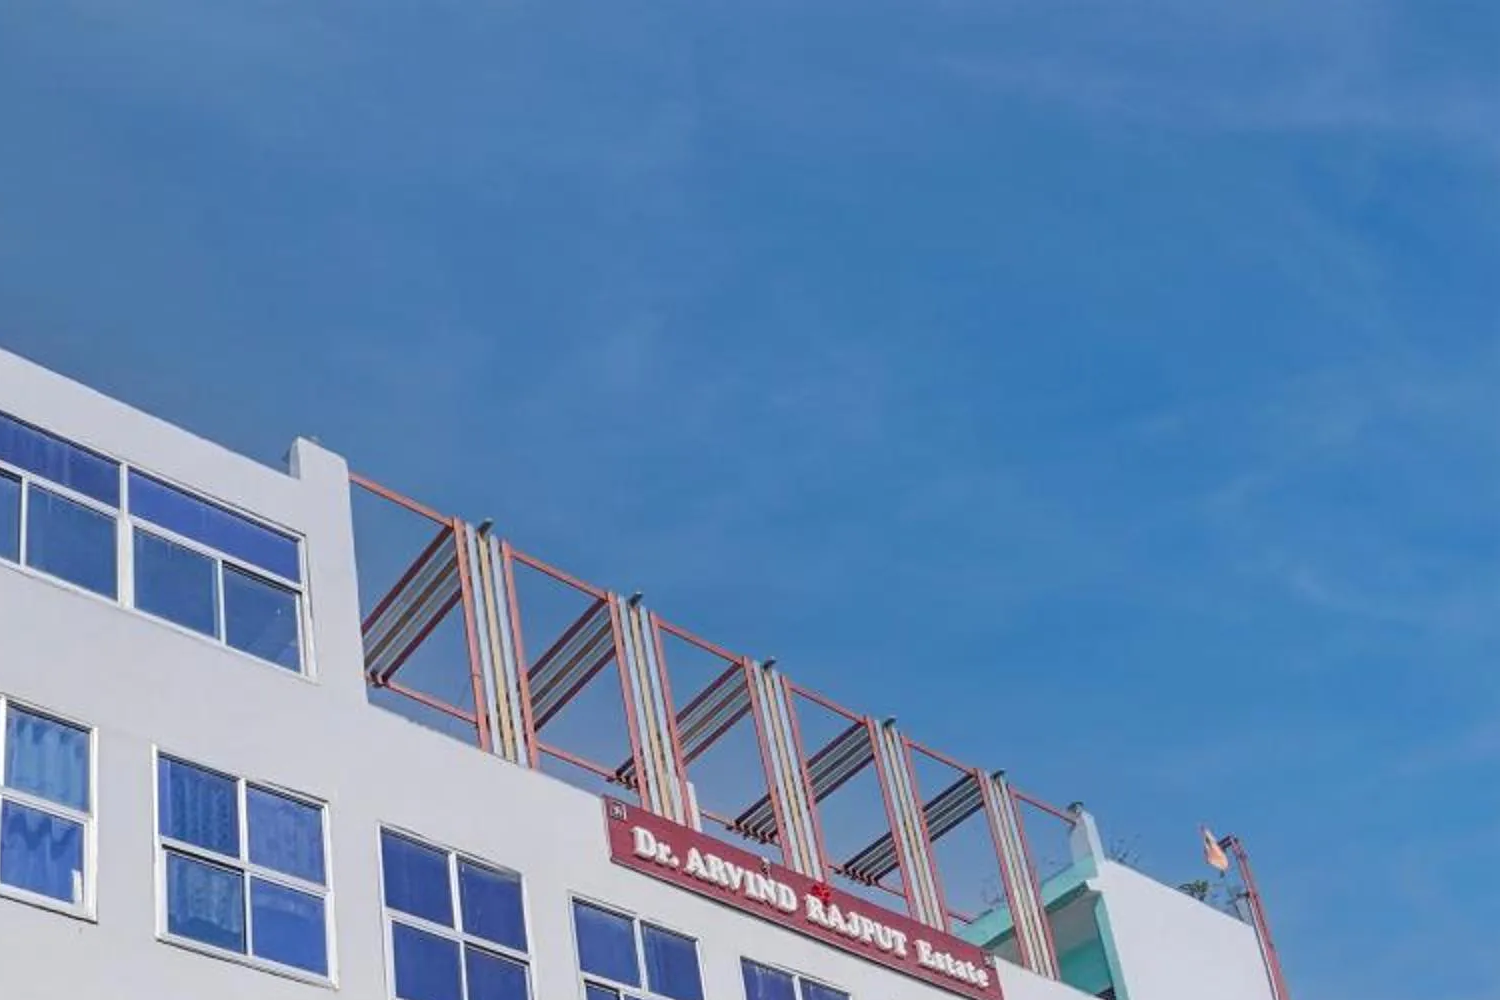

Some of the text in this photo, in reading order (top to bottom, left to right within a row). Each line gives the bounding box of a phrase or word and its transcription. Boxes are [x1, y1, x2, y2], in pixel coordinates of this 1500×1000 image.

[632, 826, 990, 989] Dr. ARVIND RAJPUT Estate
